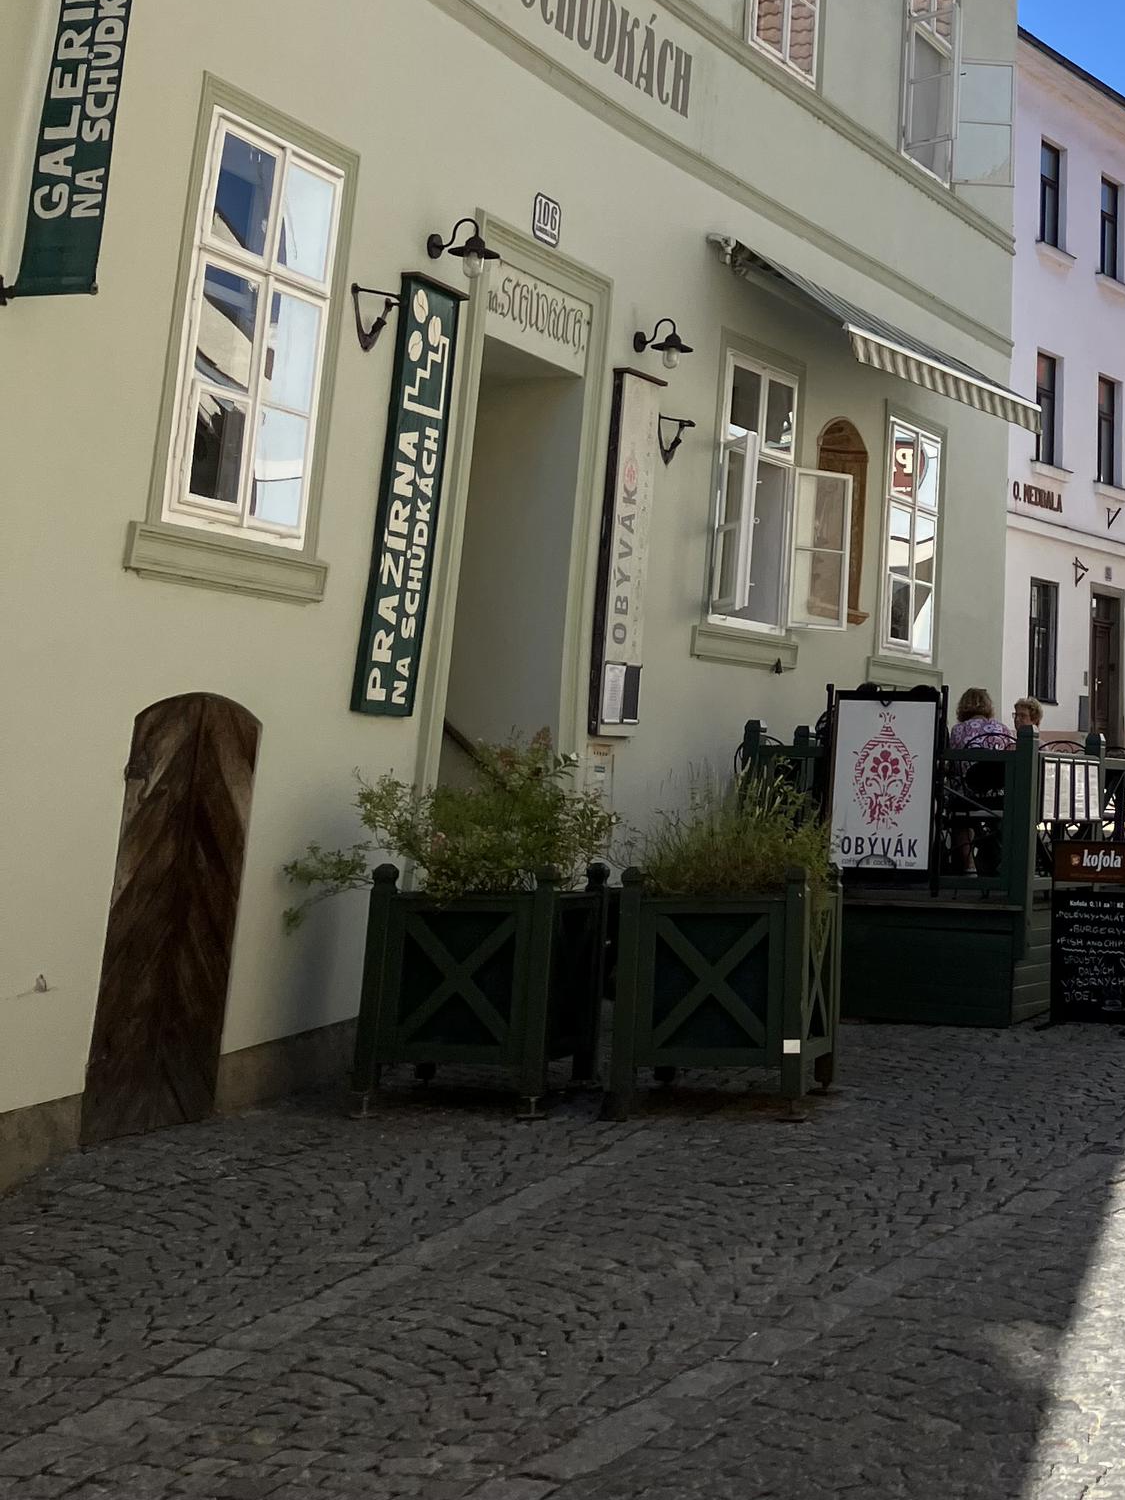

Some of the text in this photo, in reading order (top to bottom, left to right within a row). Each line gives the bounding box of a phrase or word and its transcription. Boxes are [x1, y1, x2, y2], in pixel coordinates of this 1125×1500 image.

[71, 167, 105, 218] NA
[537, 198, 557, 231] 106
[366, 431, 420, 703] PRAŽÍRNA
[391, 426, 440, 706] NA SCHŮDKÁCH
[612, 484, 638, 646] OBÝVÁK
[841, 832, 918, 858] OBÝVÁK
[1082, 849, 1122, 872] kofola
